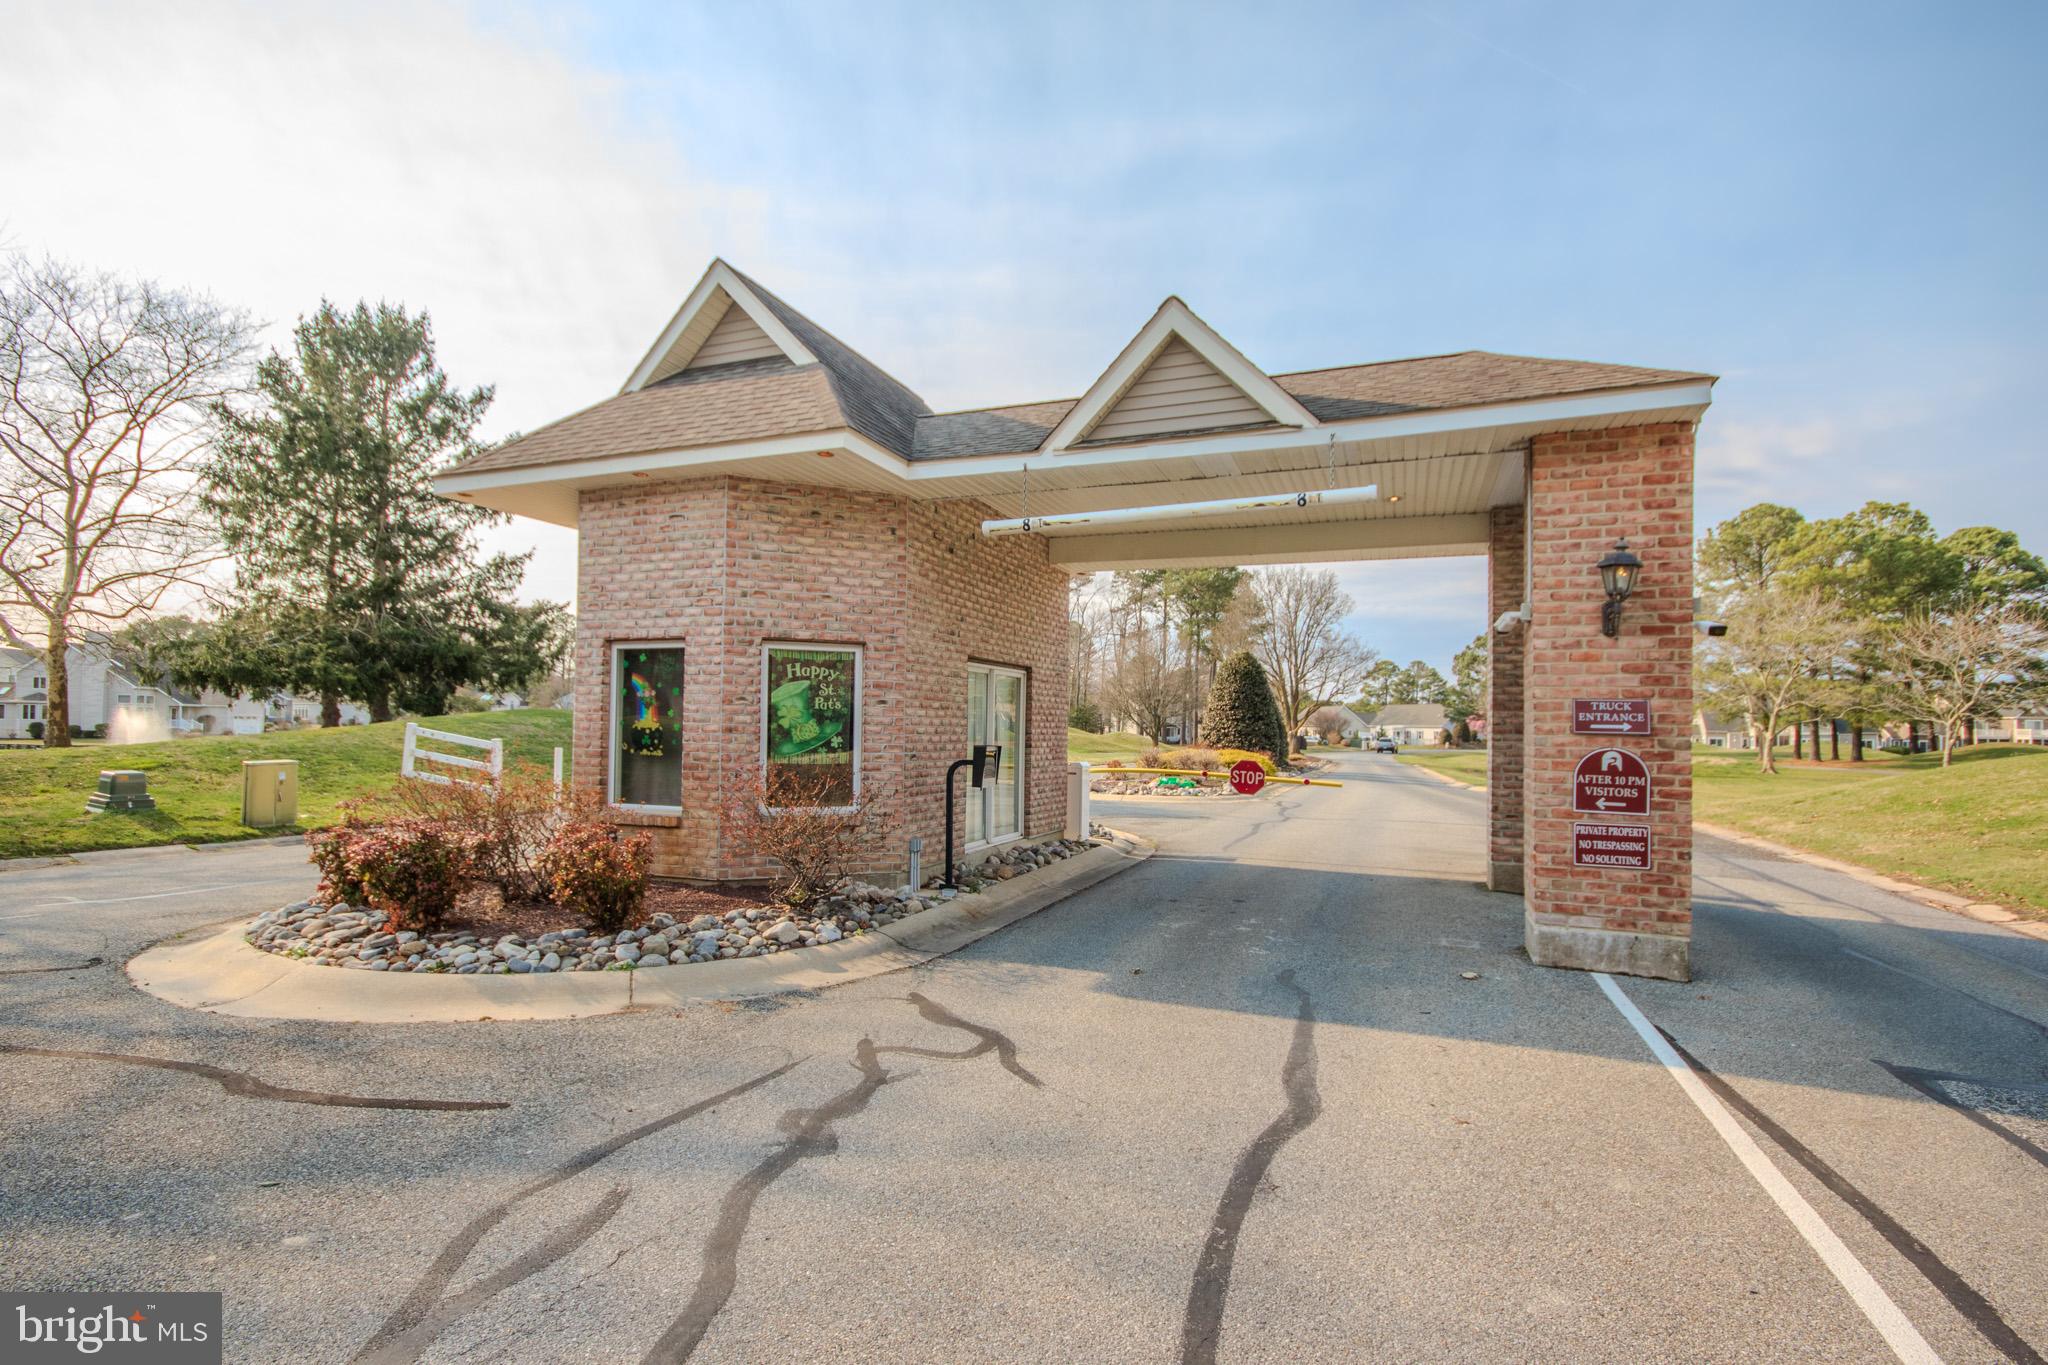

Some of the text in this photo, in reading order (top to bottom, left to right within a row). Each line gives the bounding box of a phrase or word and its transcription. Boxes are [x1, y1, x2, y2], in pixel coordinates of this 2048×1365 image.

[1298, 493, 1306, 506] 8
[1023, 518, 1030, 531] 8
[786, 662, 840, 681] Happy
[814, 697, 841, 710] Pat's
[1590, 701, 1632, 711] TRUCK
[1578, 712, 1645, 722] ENTRANCE
[1231, 770, 1264, 785] STOP
[1576, 774, 1646, 786] AFTER 10 PM
[1584, 786, 1639, 798] VISITORS
[1576, 825, 1648, 837] PRIVATE PROPERTY
[1579, 840, 1646, 852] NO TRESPASSING
[1582, 854, 1642, 866] NO SOLICITING
